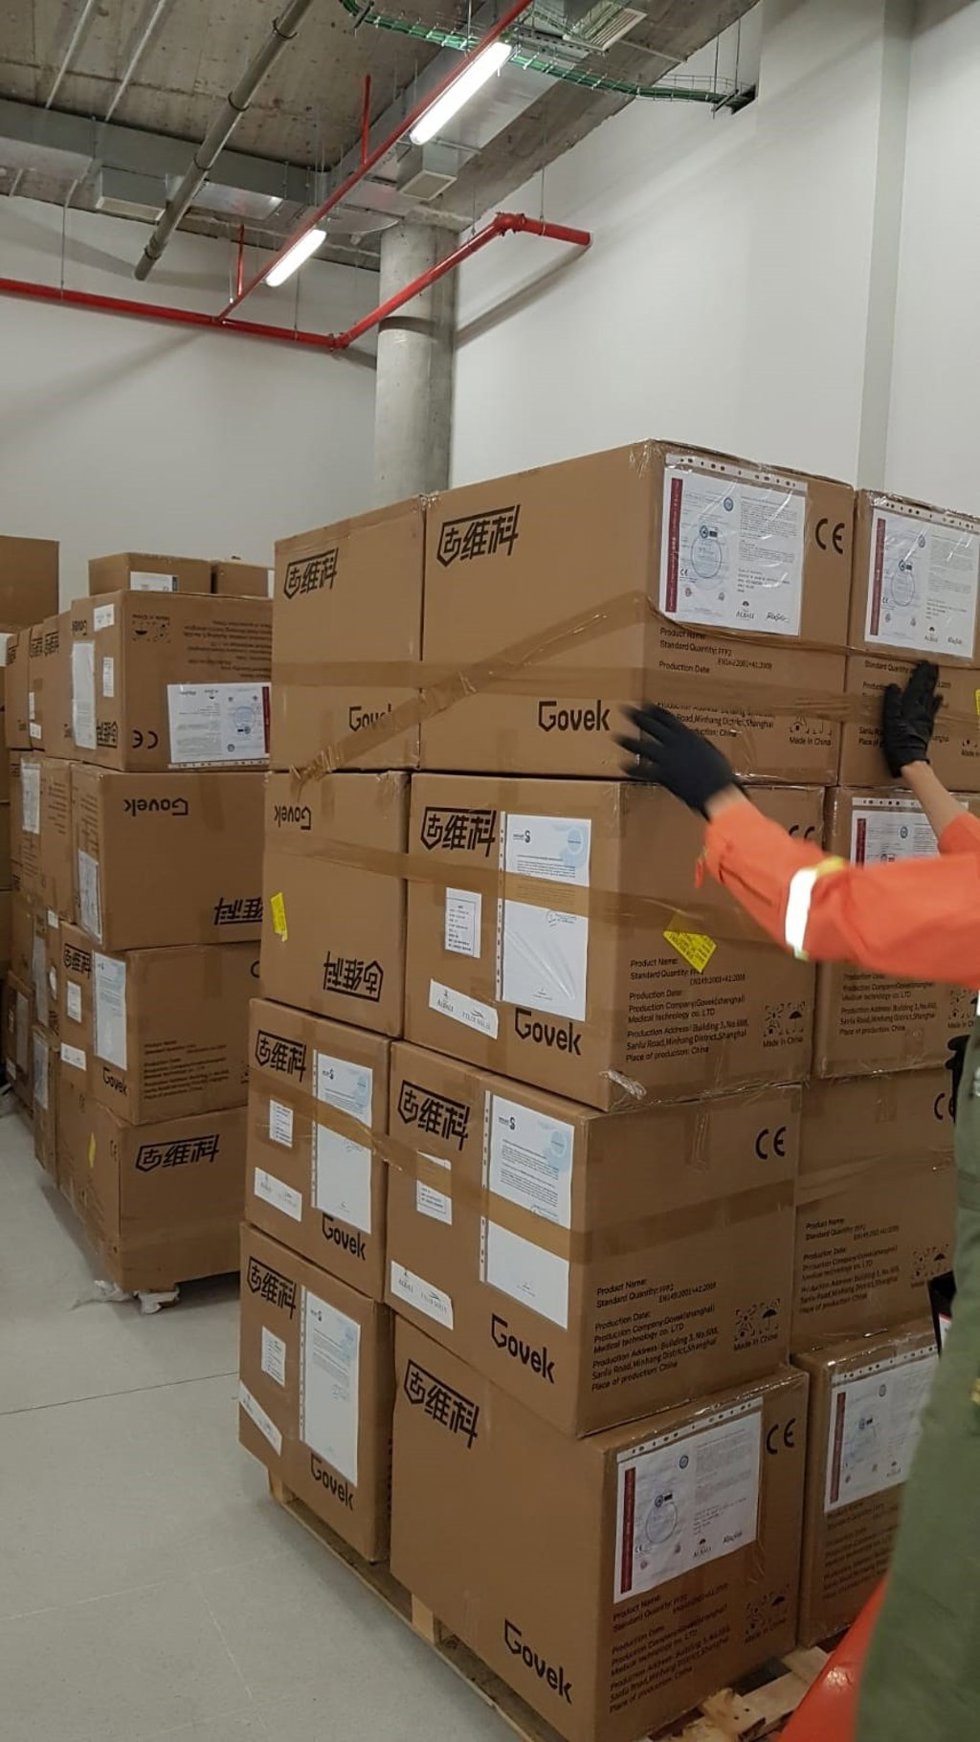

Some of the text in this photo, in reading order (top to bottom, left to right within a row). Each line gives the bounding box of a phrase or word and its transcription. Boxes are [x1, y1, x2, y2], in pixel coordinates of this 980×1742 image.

[816, 518, 845, 554] CE
[660, 640, 688, 650] Standard
[659, 661, 693, 672] Production
[349, 703, 392, 732] Gov
[538, 700, 610, 732] Govek
[720, 728, 737, 738] China
[790, 736, 806, 744] Made
[814, 738, 832, 746] China
[124, 798, 188, 816] Govek
[274, 806, 312, 830] Govek
[630, 959, 656, 968] Product
[630, 970, 661, 980] Standard
[630, 990, 664, 1000] Production
[864, 992, 890, 1000] technology
[628, 1002, 664, 1012] Production
[894, 1004, 914, 1012] Building
[628, 1008, 716, 1023] Medical technology LTD
[514, 1008, 582, 1056] Govek
[628, 1028, 662, 1038] Production
[693, 1022, 719, 1032] Building
[627, 1041, 646, 1050] Sanlu
[763, 1040, 778, 1048] Made
[787, 1036, 804, 1044] China
[626, 1053, 644, 1062] Place
[646, 1052, 654, 1060] of
[691, 1046, 709, 1054] China
[102, 1067, 128, 1096] Govek
[756, 1126, 786, 1160] CE
[806, 1221, 828, 1229] Product
[322, 1213, 366, 1261] Govek
[806, 1231, 830, 1240] Standard
[804, 1250, 832, 1259] Production
[862, 1260, 873, 1268] LTD
[597, 1284, 624, 1296] Product
[596, 1295, 628, 1308] Standard
[595, 1316, 632, 1330] Production
[594, 1328, 632, 1343] Production
[594, 1323, 684, 1354] Medical technology LTD
[734, 1341, 751, 1351] Made
[760, 1333, 778, 1344] China
[492, 1314, 556, 1384] Govek
[592, 1354, 630, 1368] Production
[660, 1336, 688, 1350] Building
[592, 1368, 612, 1380] Sanlu
[592, 1380, 610, 1392] Place
[612, 1377, 620, 1386] of
[659, 1361, 678, 1372] China
[766, 1417, 796, 1456] CE
[310, 1452, 354, 1511] Govek
[613, 1614, 642, 1632] Standard
[612, 1634, 648, 1654] Production
[504, 1618, 572, 1704] Govek
[612, 1646, 647, 1667] Production
[611, 1670, 646, 1690] Production
